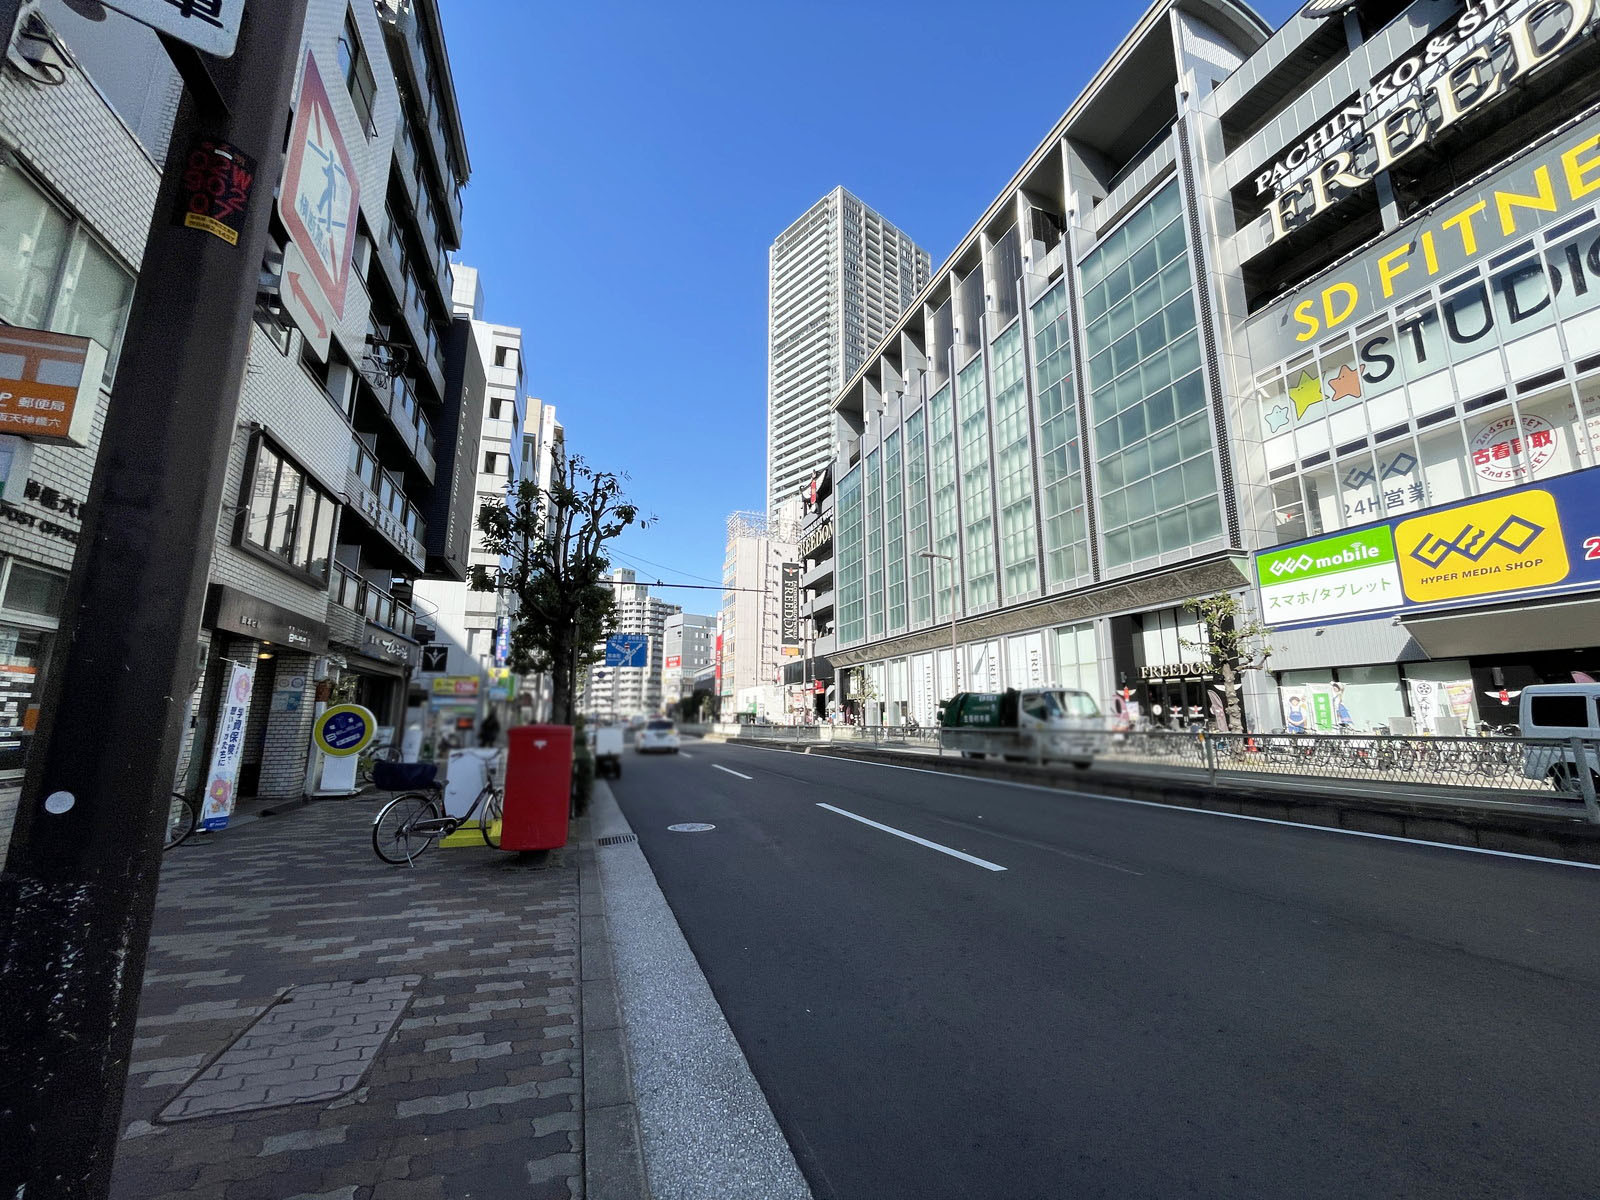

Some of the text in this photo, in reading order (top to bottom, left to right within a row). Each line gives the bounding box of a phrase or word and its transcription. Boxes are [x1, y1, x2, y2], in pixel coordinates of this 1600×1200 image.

[1254, 57, 1421, 196] PACHINKO
[1293, 282, 1359, 342] SD
[1359, 233, 1600, 385] STUDI
[18, 396, 65, 412] 郵便局
[1316, 543, 1380, 568] mobile
[1420, 558, 1544, 585] HYPER MEDIA SHOP
